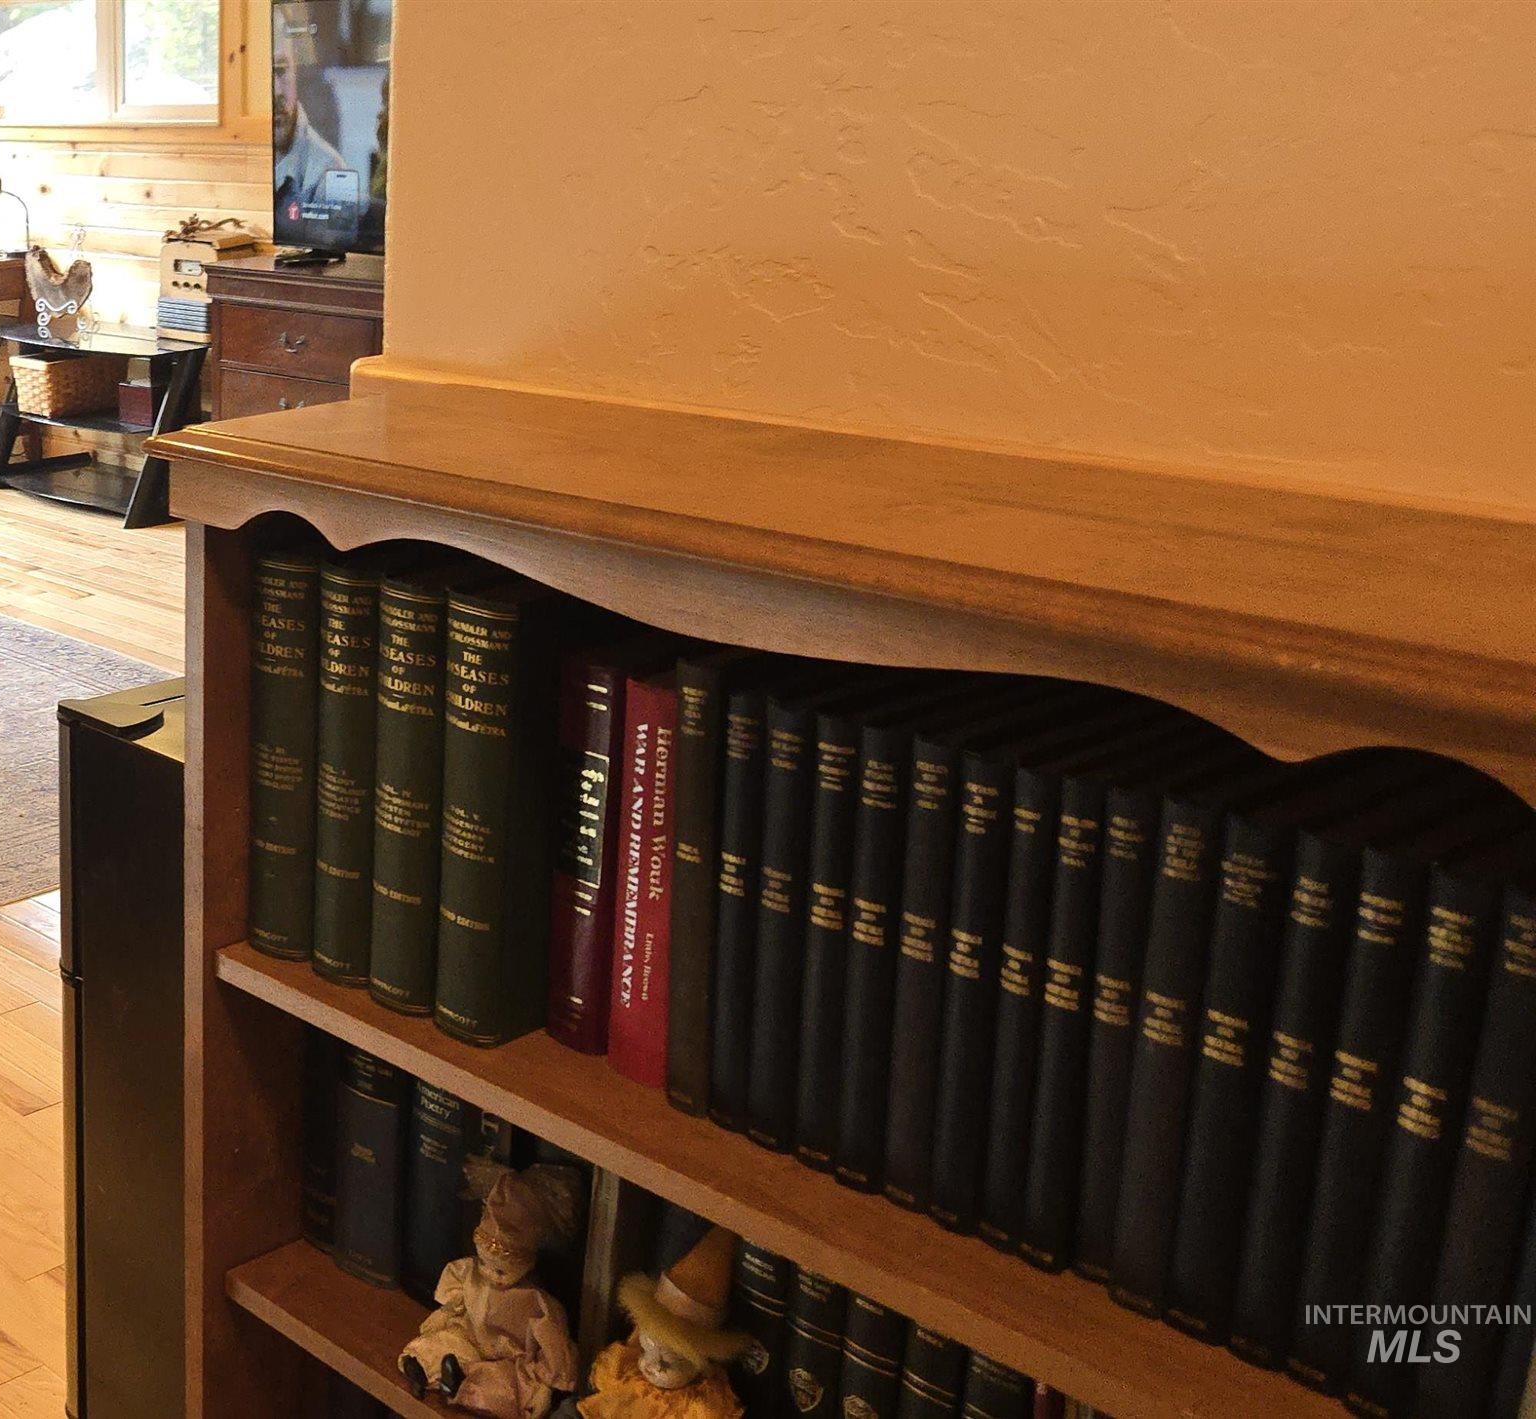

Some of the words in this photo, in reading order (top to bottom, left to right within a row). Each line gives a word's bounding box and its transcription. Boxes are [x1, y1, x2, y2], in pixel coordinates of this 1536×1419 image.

[390, 633, 409, 648] THE
[463, 651, 482, 665] THE
[391, 665, 405, 676] OF
[462, 683, 477, 694] OF
[636, 723, 648, 775] WAR
[652, 726, 672, 827] Herman
[631, 779, 644, 830] AND
[648, 834, 667, 901] Wouk
[622, 832, 641, 1008] REMEMBRANCE
